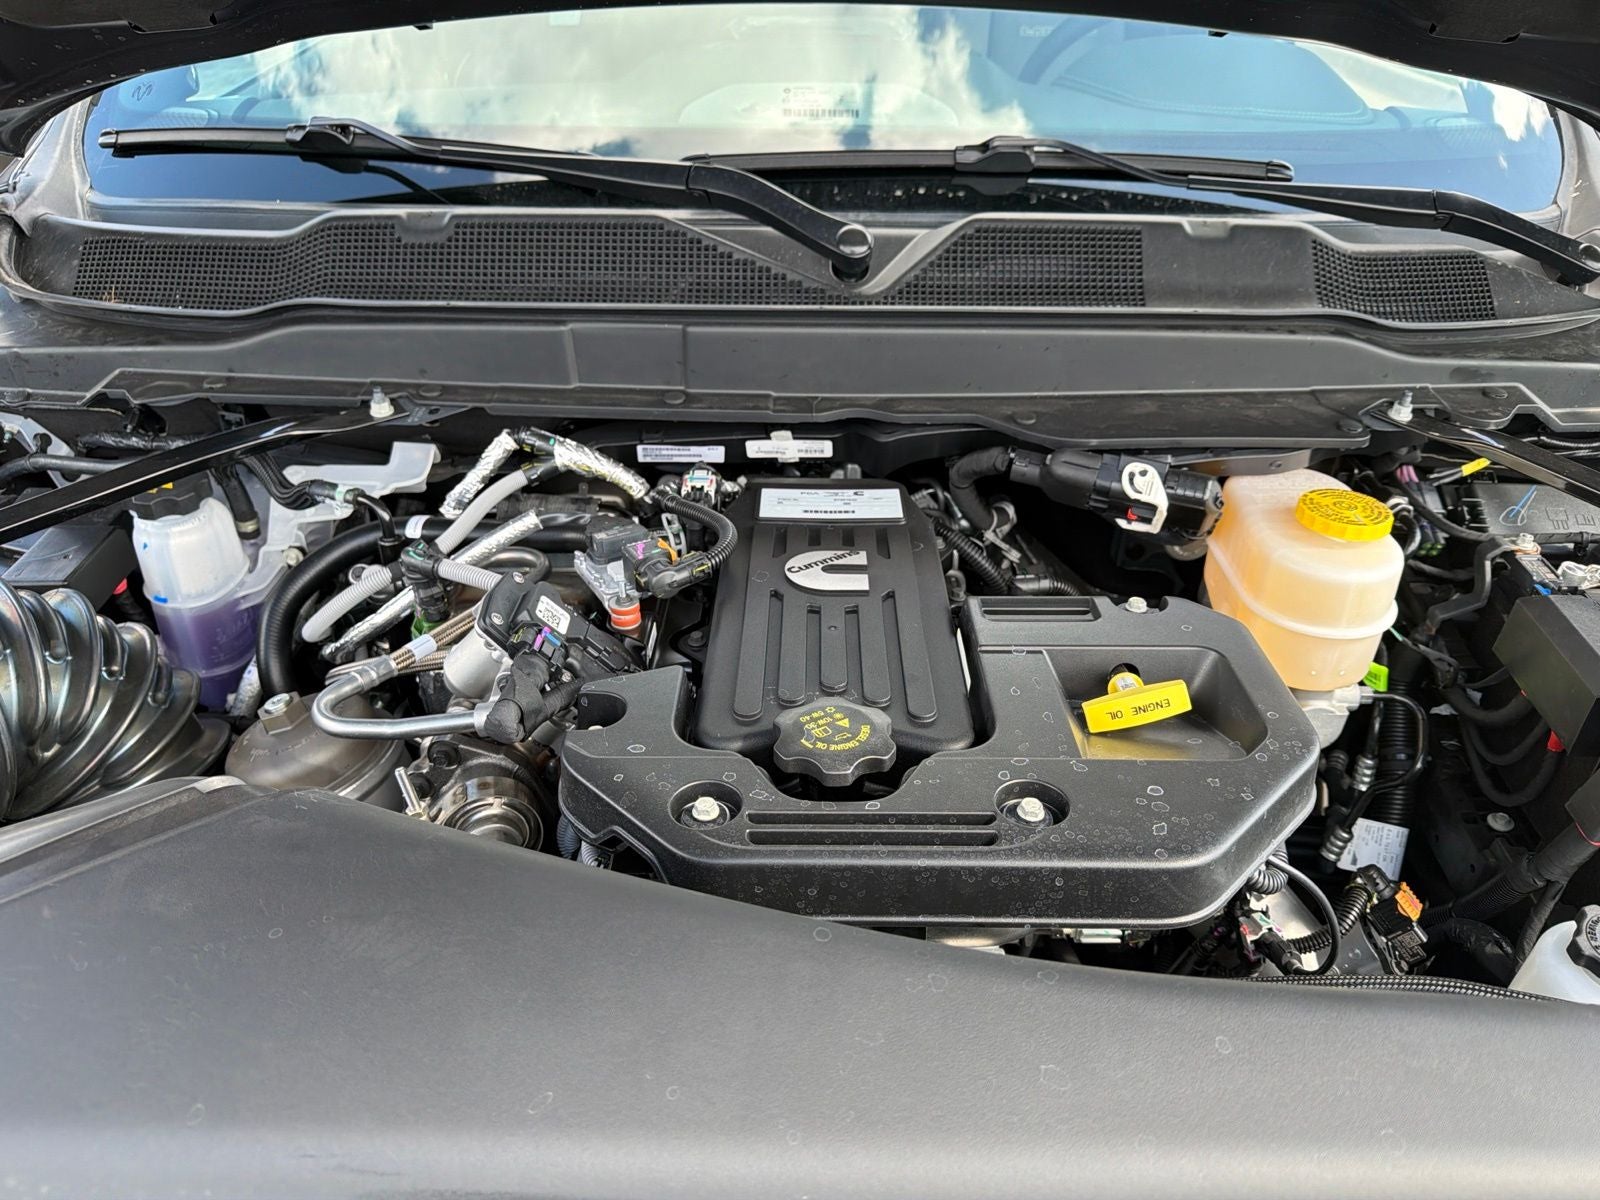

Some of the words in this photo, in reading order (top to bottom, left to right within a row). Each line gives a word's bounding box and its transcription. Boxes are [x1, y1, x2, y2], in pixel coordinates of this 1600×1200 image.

[786, 550, 860, 574] Cummins
[1131, 698, 1171, 716] ENGINE
[799, 710, 825, 723] 5W-40
[1106, 710, 1124, 721] OIL
[804, 716, 834, 730] 10W-30
[815, 741, 828, 750] OIL
[828, 740, 860, 751] ENGINE
